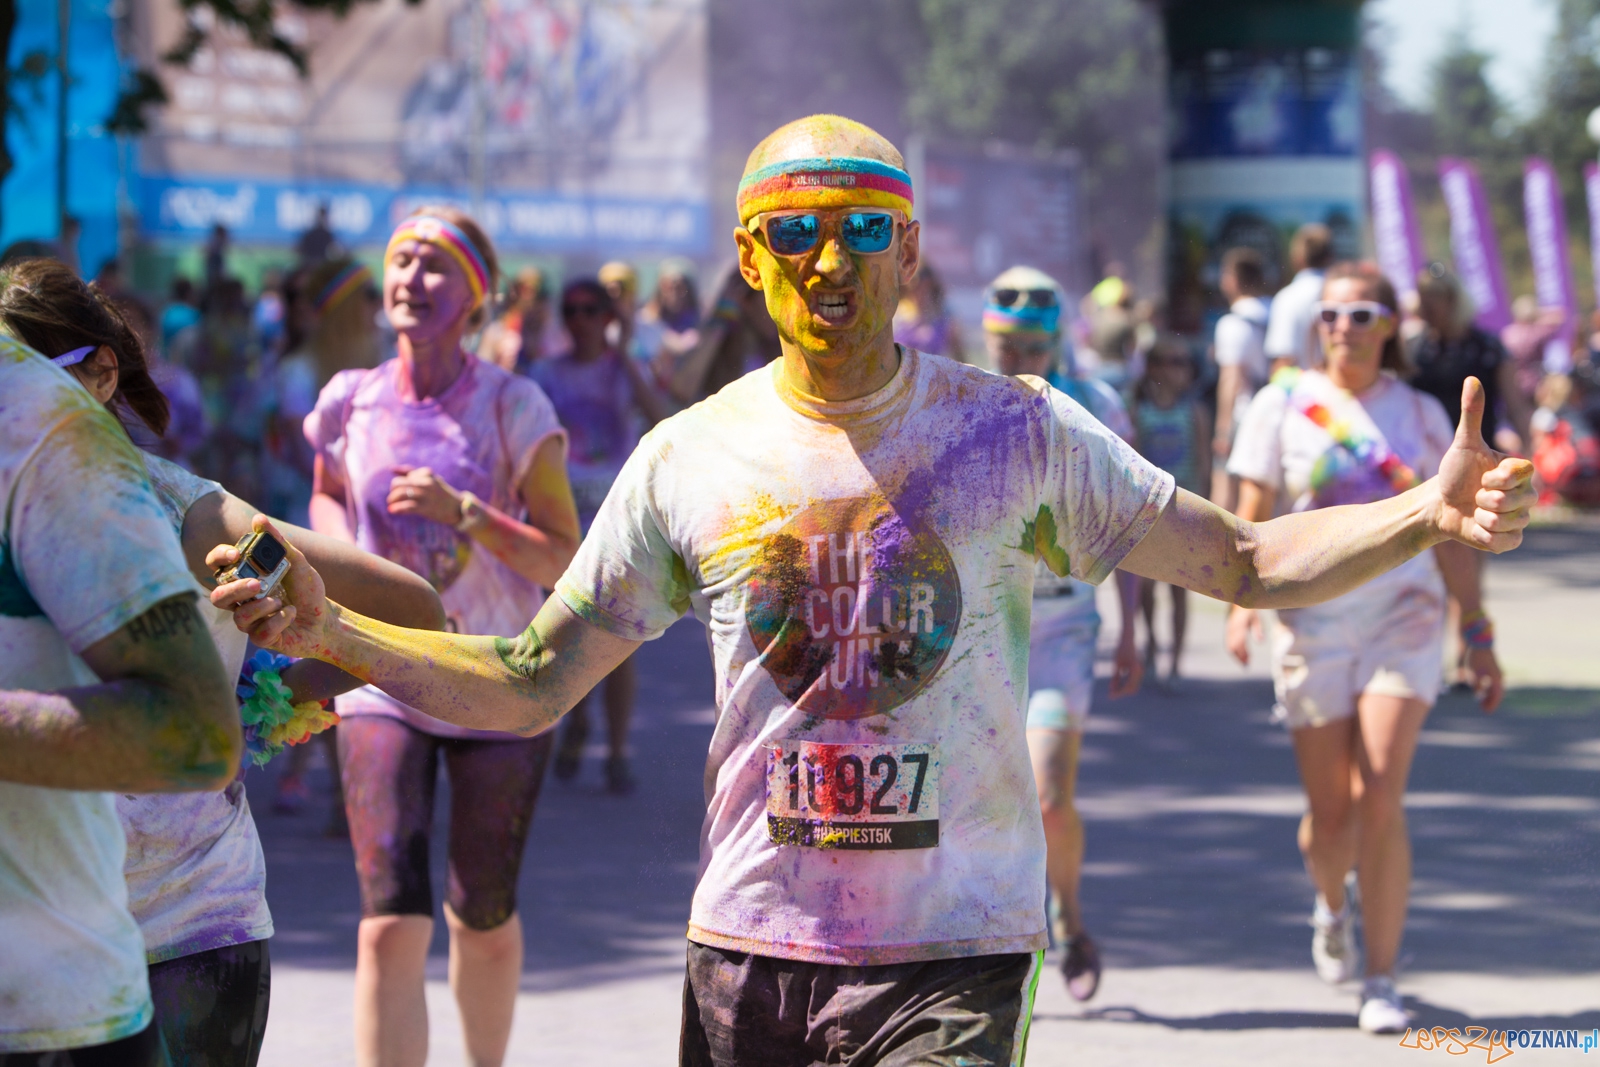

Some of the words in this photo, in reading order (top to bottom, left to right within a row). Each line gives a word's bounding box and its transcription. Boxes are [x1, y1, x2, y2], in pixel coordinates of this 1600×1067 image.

[822, 175, 855, 186] RUNNER
[806, 582, 934, 638] COLOR
[818, 637, 880, 690] UN
[783, 751, 929, 816] 10927
